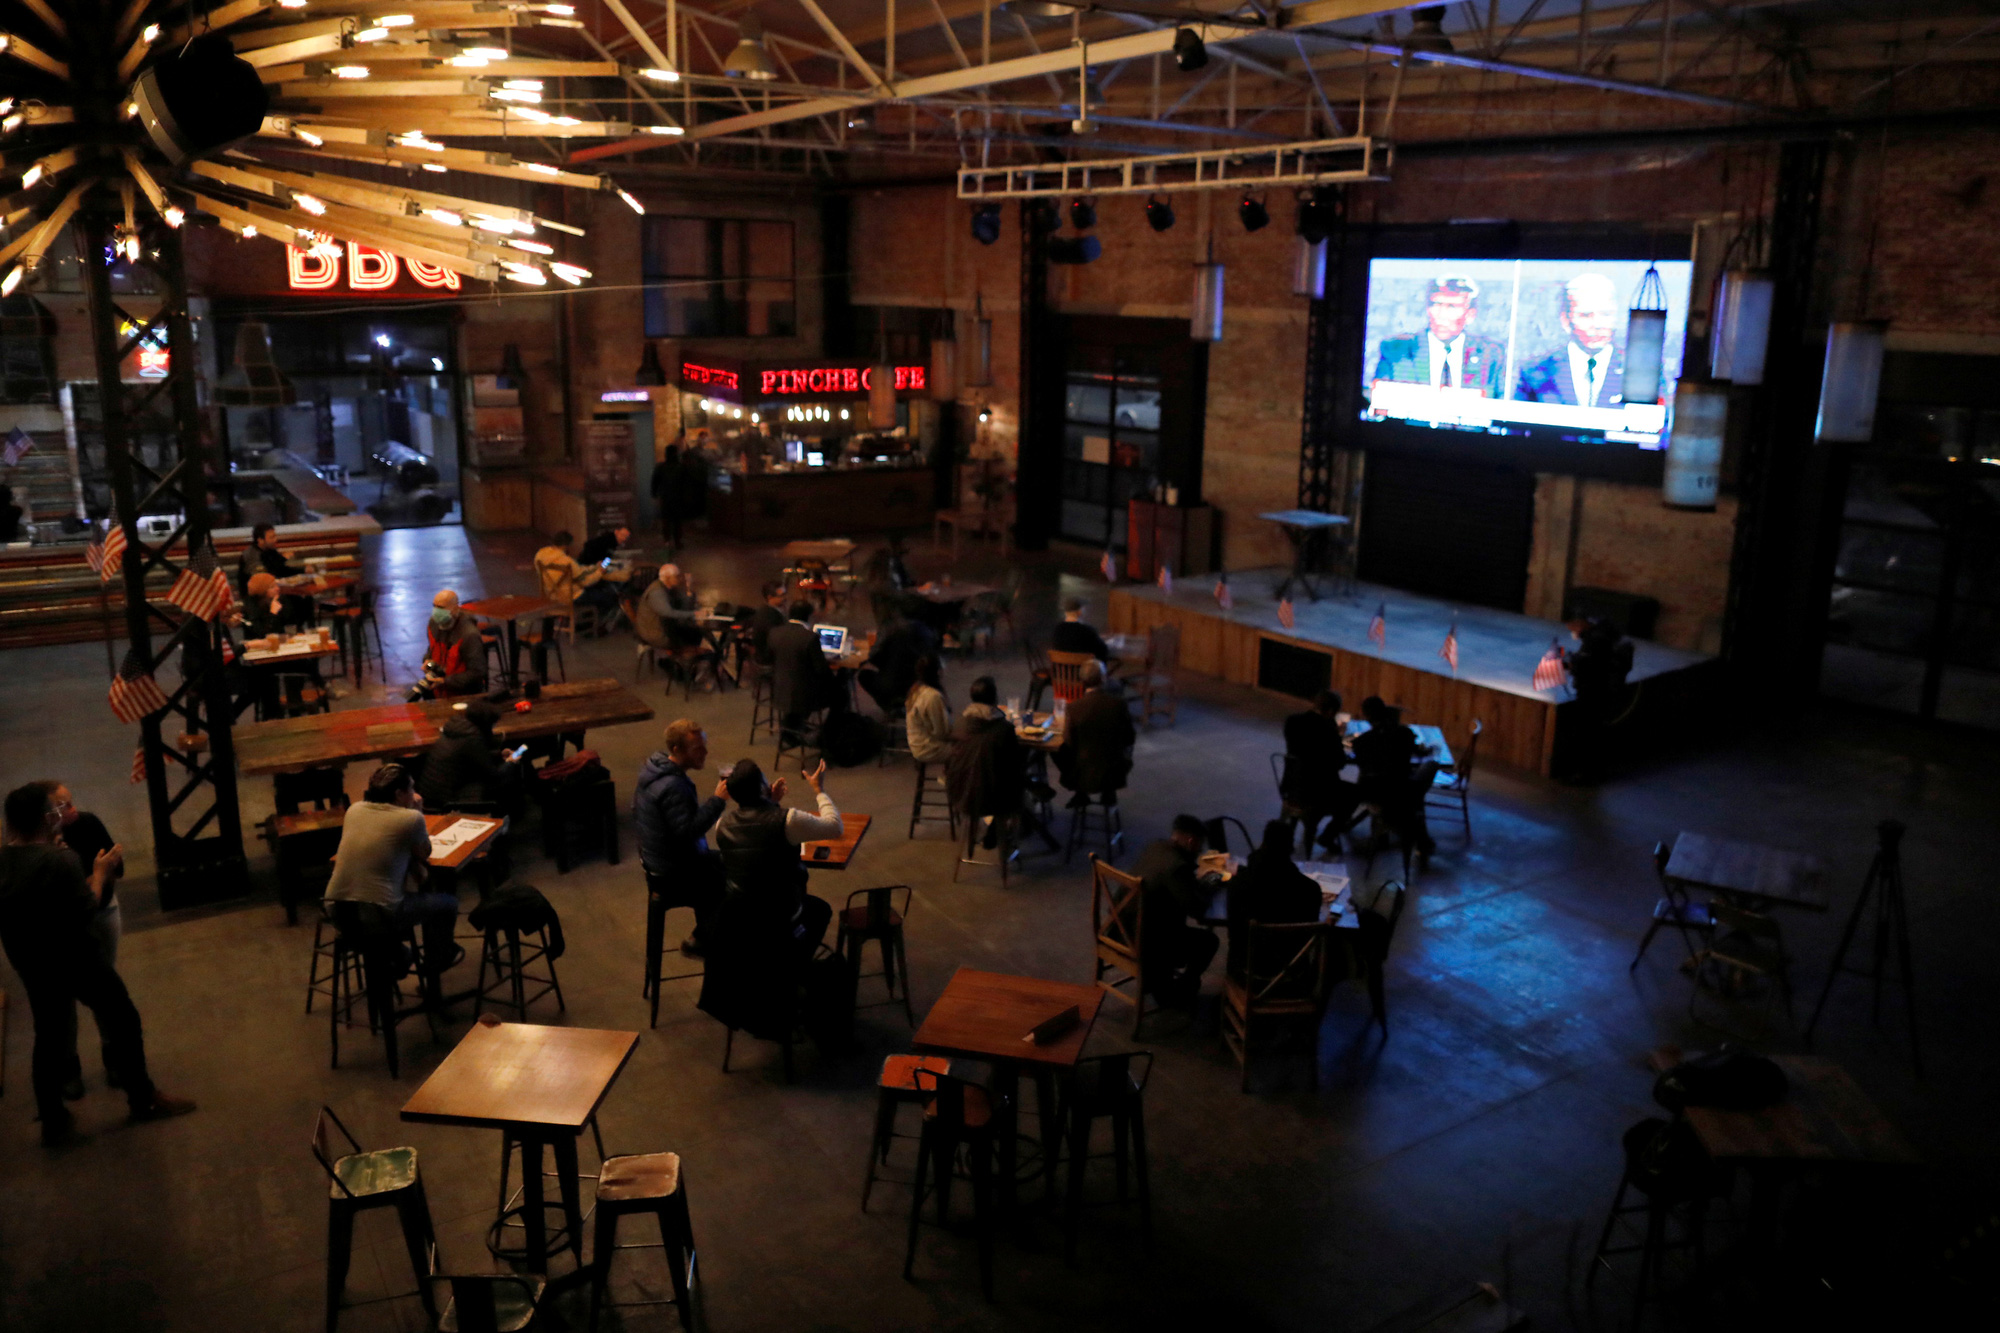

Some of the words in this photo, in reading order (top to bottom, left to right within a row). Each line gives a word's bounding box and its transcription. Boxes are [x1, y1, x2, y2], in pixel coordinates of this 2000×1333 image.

[286, 236, 462, 291] BBQ
[761, 368, 859, 394] PINCHE
[861, 366, 925, 390] CFE
